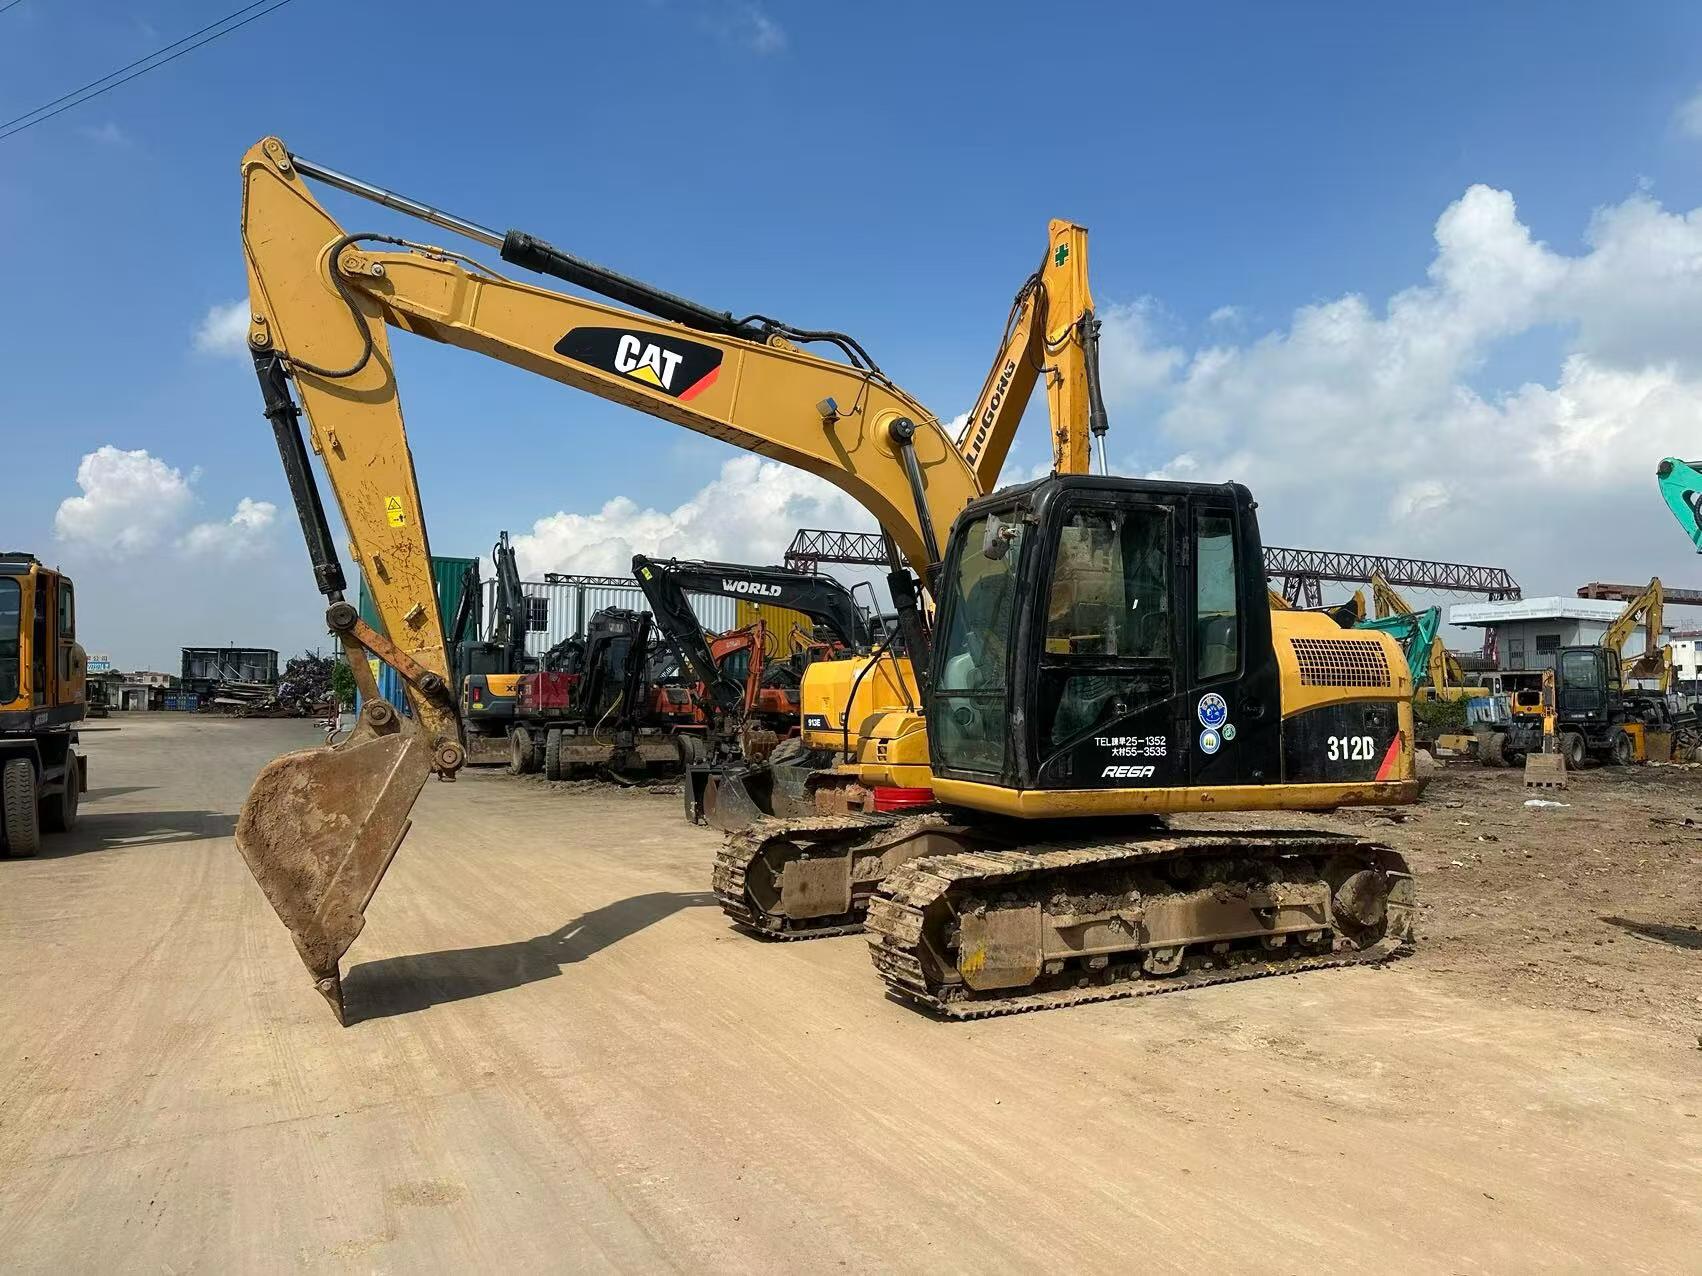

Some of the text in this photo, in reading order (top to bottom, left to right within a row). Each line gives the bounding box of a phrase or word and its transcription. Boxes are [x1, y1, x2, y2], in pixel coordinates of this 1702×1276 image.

[614, 334, 683, 390] CAT
[966, 359, 1016, 467] LIUGONG
[722, 579, 782, 597] WORLD
[807, 719, 821, 727] 913E
[1327, 736, 1375, 761] 312D
[1101, 765, 1155, 778] REGA
